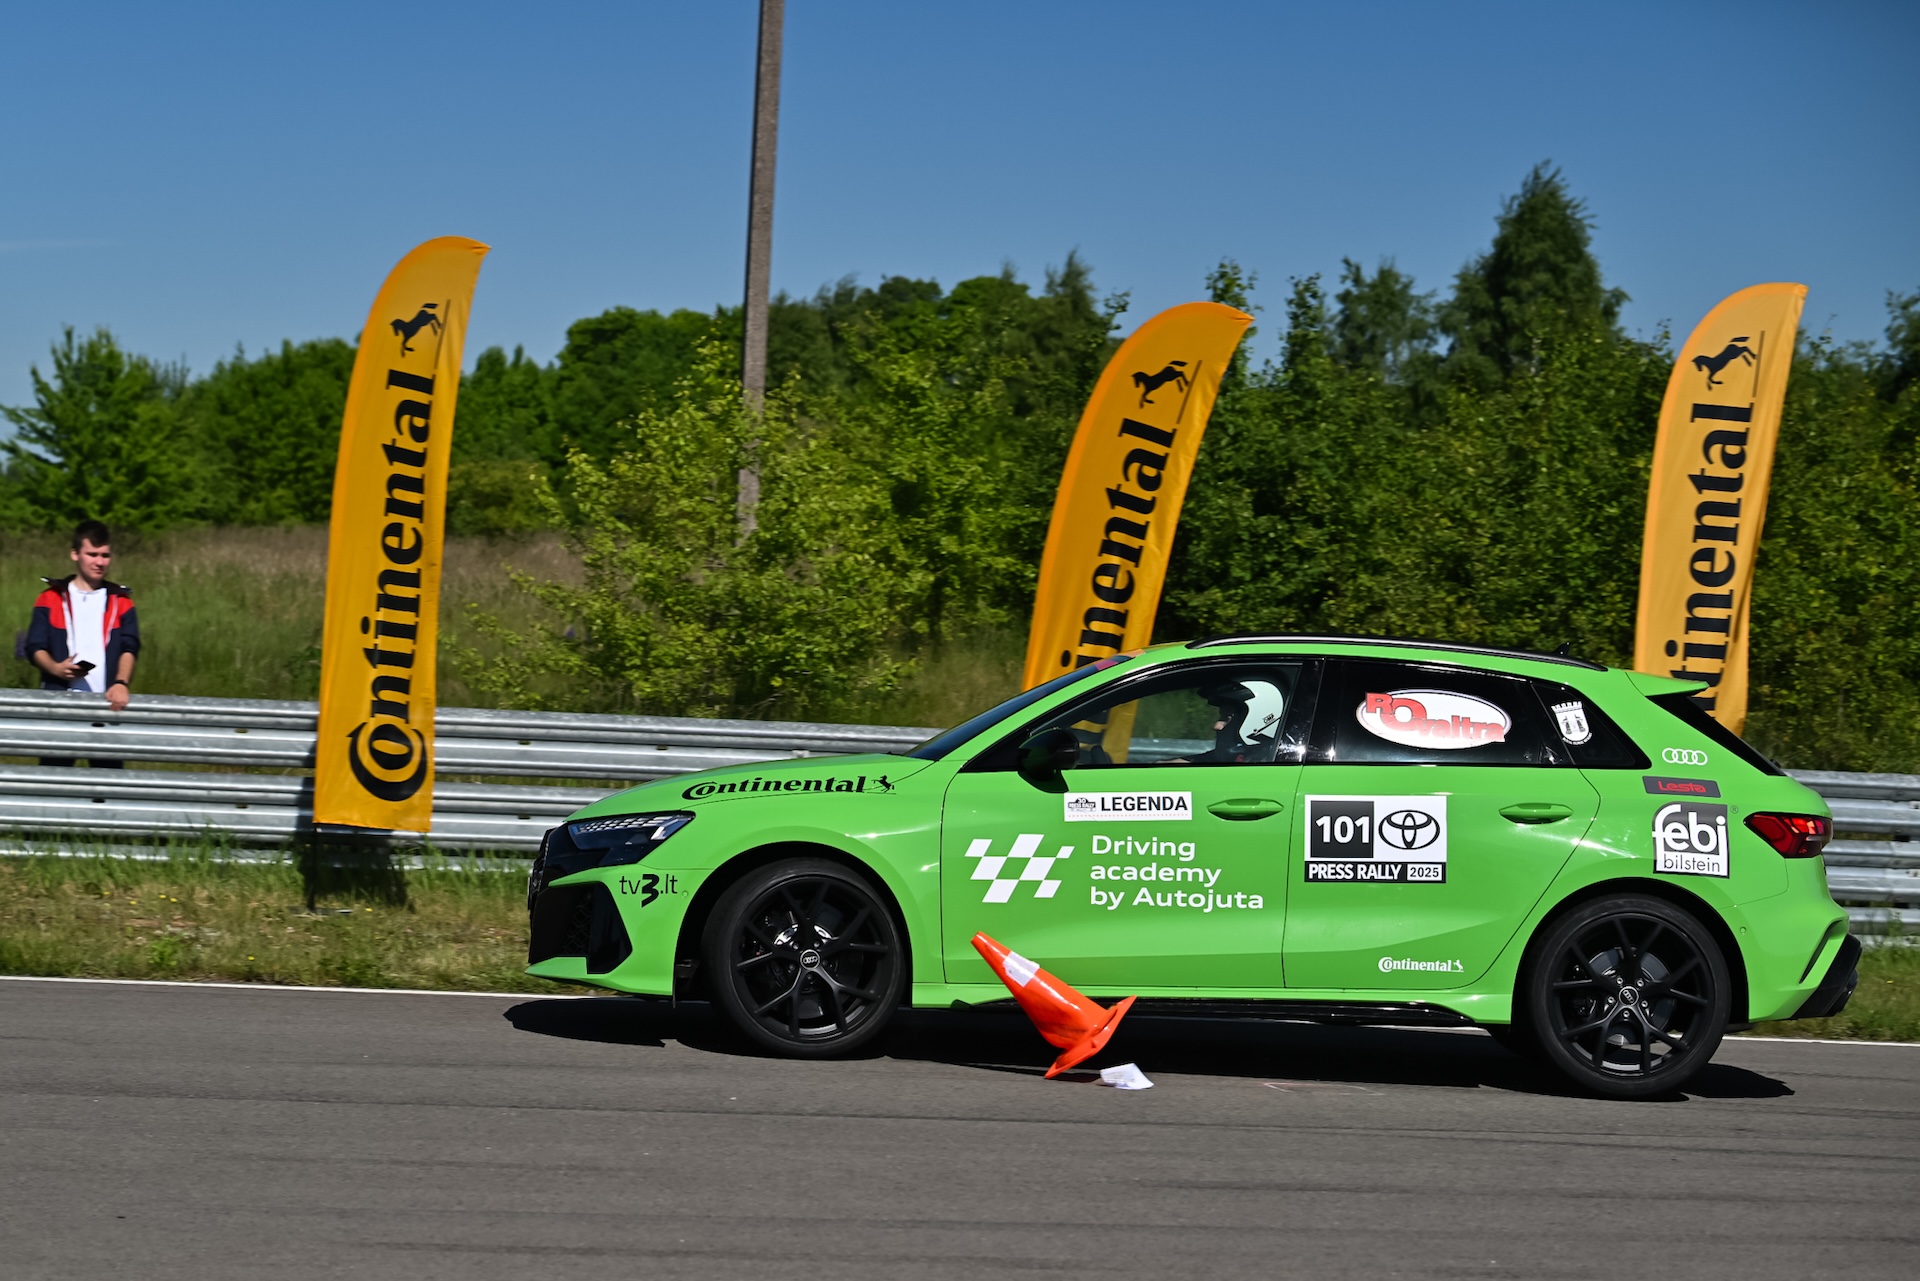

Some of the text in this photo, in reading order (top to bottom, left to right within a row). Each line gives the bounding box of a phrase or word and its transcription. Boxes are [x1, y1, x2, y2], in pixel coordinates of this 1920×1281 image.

[348, 368, 435, 801] Continental
[681, 775, 867, 800] Continental
[1101, 795, 1188, 811] LEGENDA
[1315, 815, 1370, 843] 101
[1652, 804, 1728, 853] febi
[1091, 835, 1196, 861] Driving
[1090, 862, 1222, 887] academy
[1308, 863, 1440, 880] PRESS RALLY 2025
[1663, 853, 1720, 873] bilstein
[619, 873, 678, 908] tv3.lt
[1090, 886, 1264, 913] by Autojuta
[1378, 956, 1452, 973] Continental
